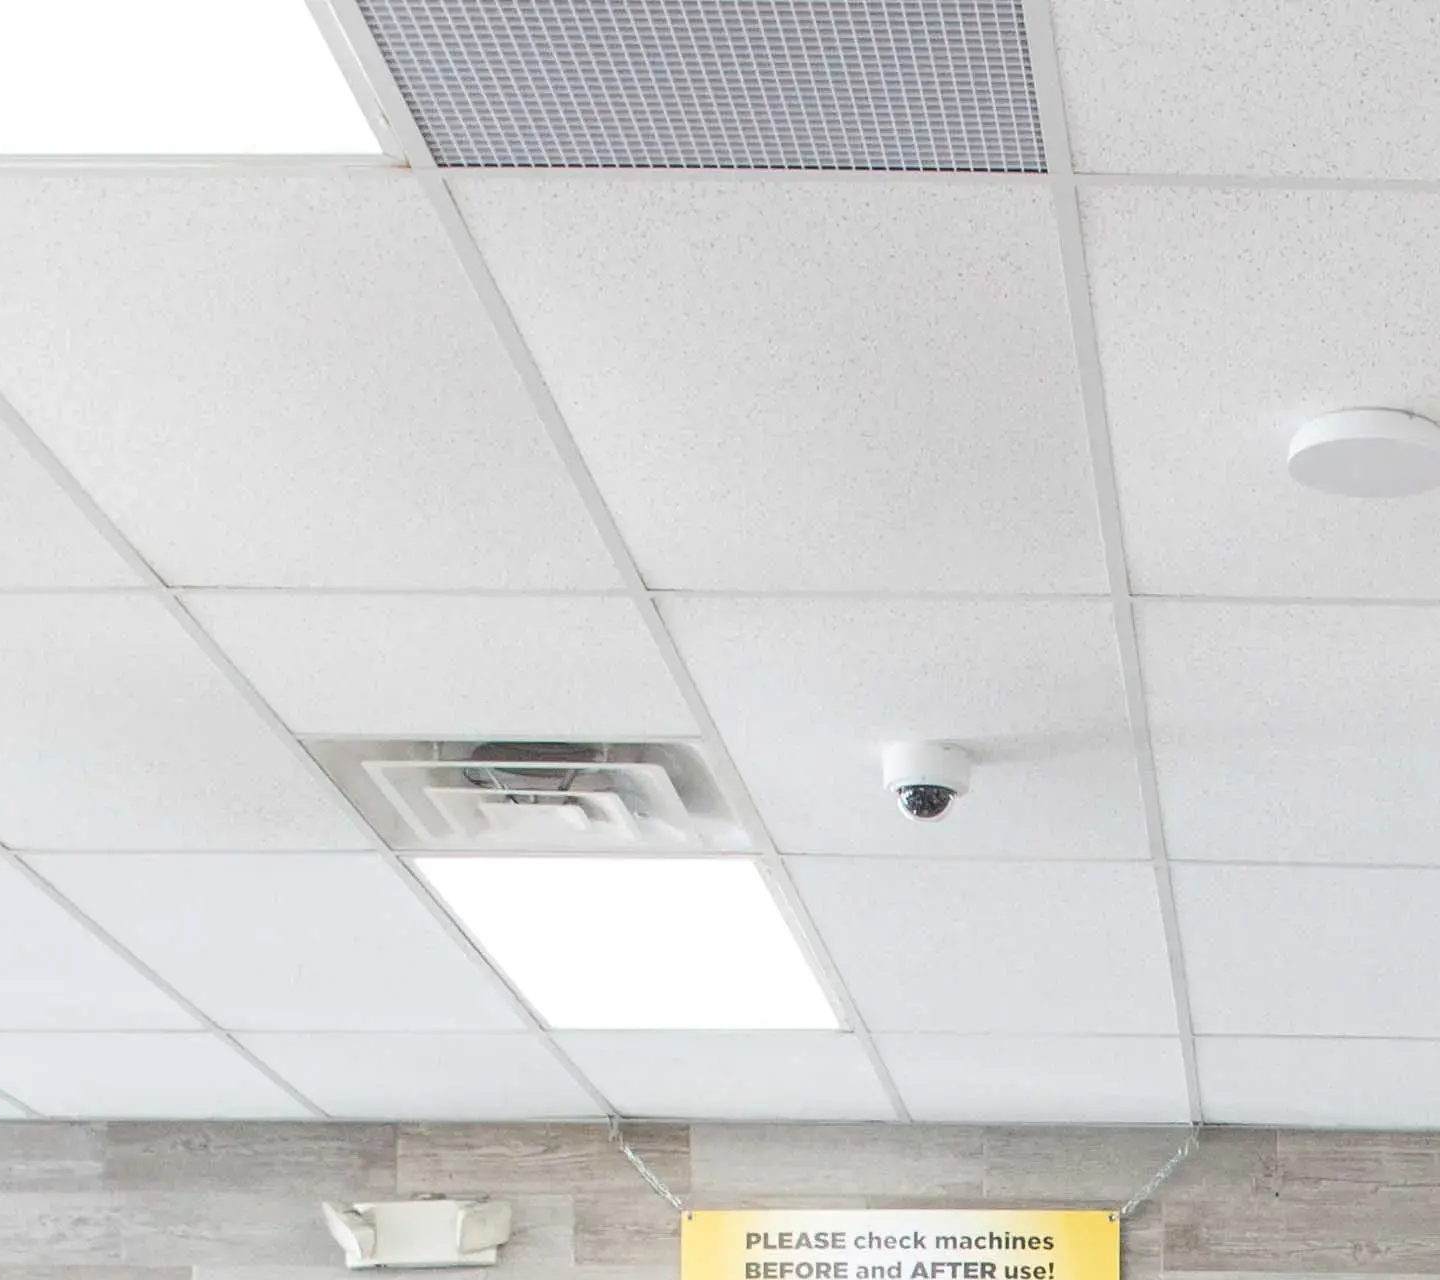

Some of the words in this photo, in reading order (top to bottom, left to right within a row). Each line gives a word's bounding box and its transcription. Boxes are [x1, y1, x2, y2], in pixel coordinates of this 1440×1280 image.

[745, 1232, 846, 1250] PLEASE
[854, 1231, 926, 1250] check
[935, 1231, 1054, 1250] machines
[745, 1262, 848, 1280] BEFORE
[855, 1262, 902, 1280] and
[910, 1262, 997, 1280] AFTER
[1004, 1262, 1054, 1280] use!
